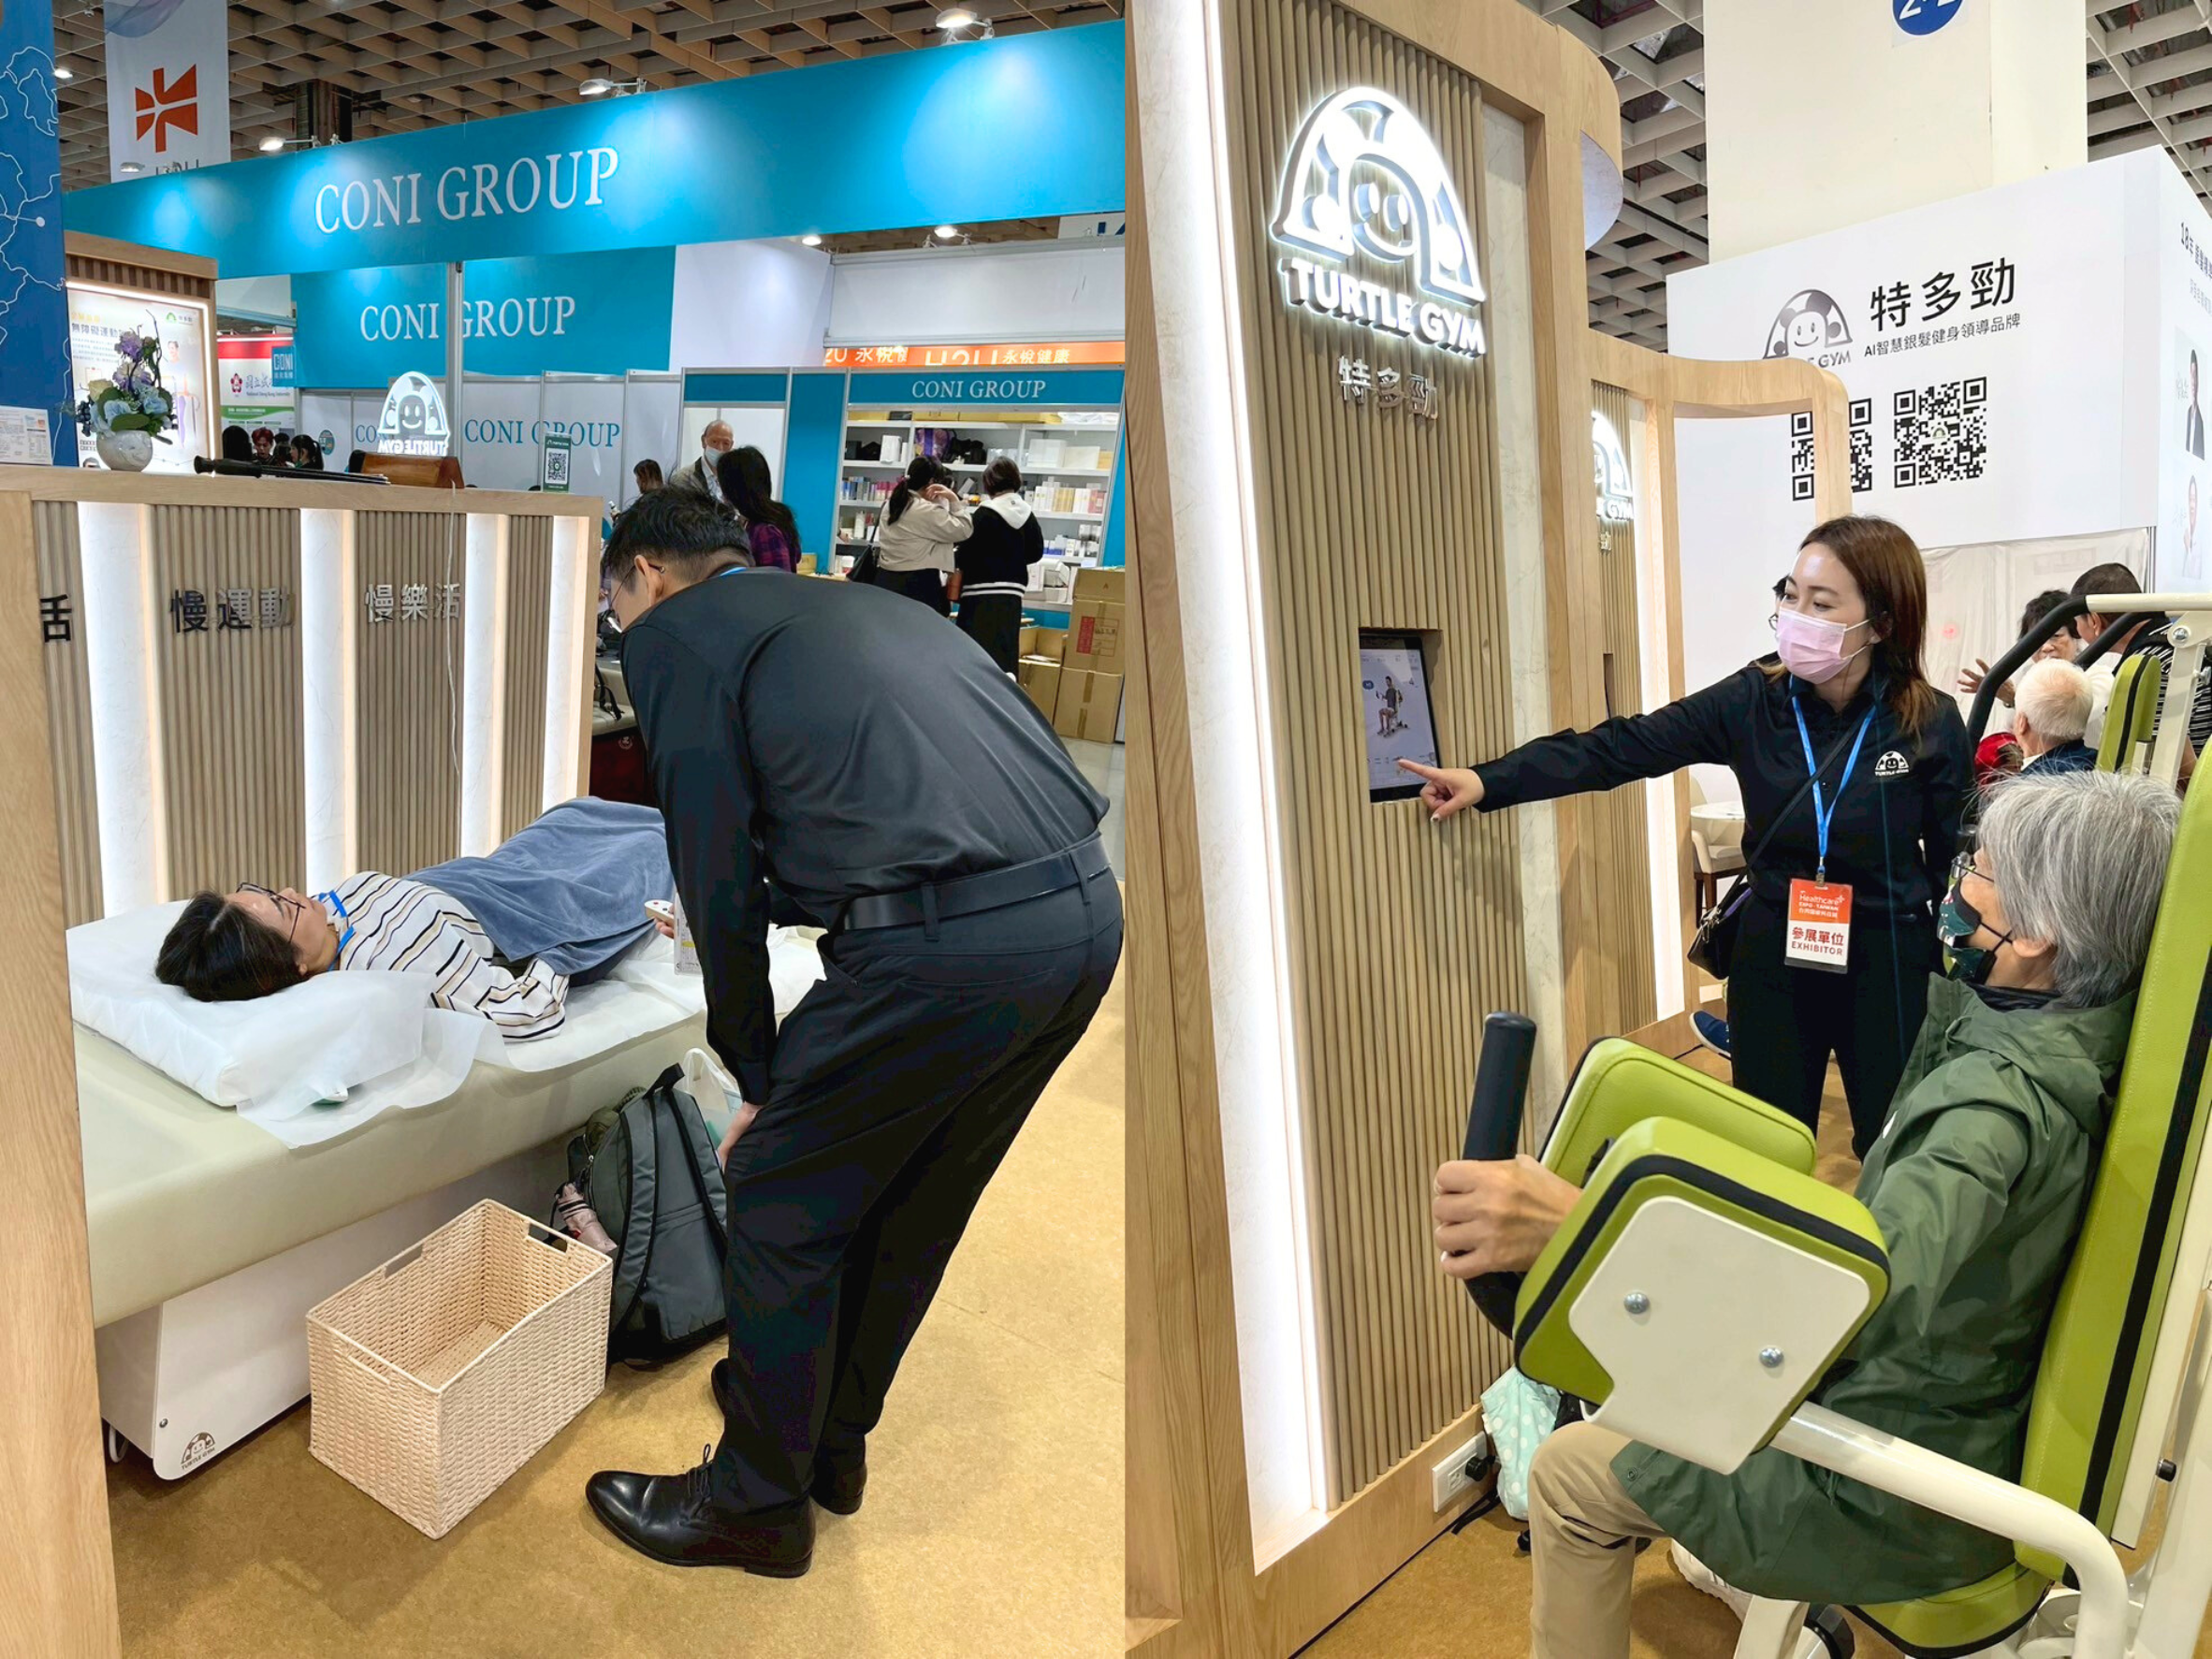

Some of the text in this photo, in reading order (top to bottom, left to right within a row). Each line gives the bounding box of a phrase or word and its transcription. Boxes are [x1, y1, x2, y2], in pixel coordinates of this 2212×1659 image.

[315, 146, 618, 234] CONI GROUP
[1278, 258, 1486, 358] TURTLE GYM
[1870, 257, 2016, 331] 特多勁
[360, 302, 440, 342] CONI
[1864, 313, 2021, 357] AI智慧銀髮健身領導品牌
[1817, 350, 1851, 369] GYM
[911, 380, 1047, 399] CONI GROUP
[1338, 357, 1438, 419] 特多勁
[464, 418, 524, 444] CONI
[169, 587, 297, 634] 慢運動
[365, 582, 461, 623] 慢樂活
[1791, 940, 1843, 955] EXHIBITOR
[1792, 926, 1843, 946] 參展單位
